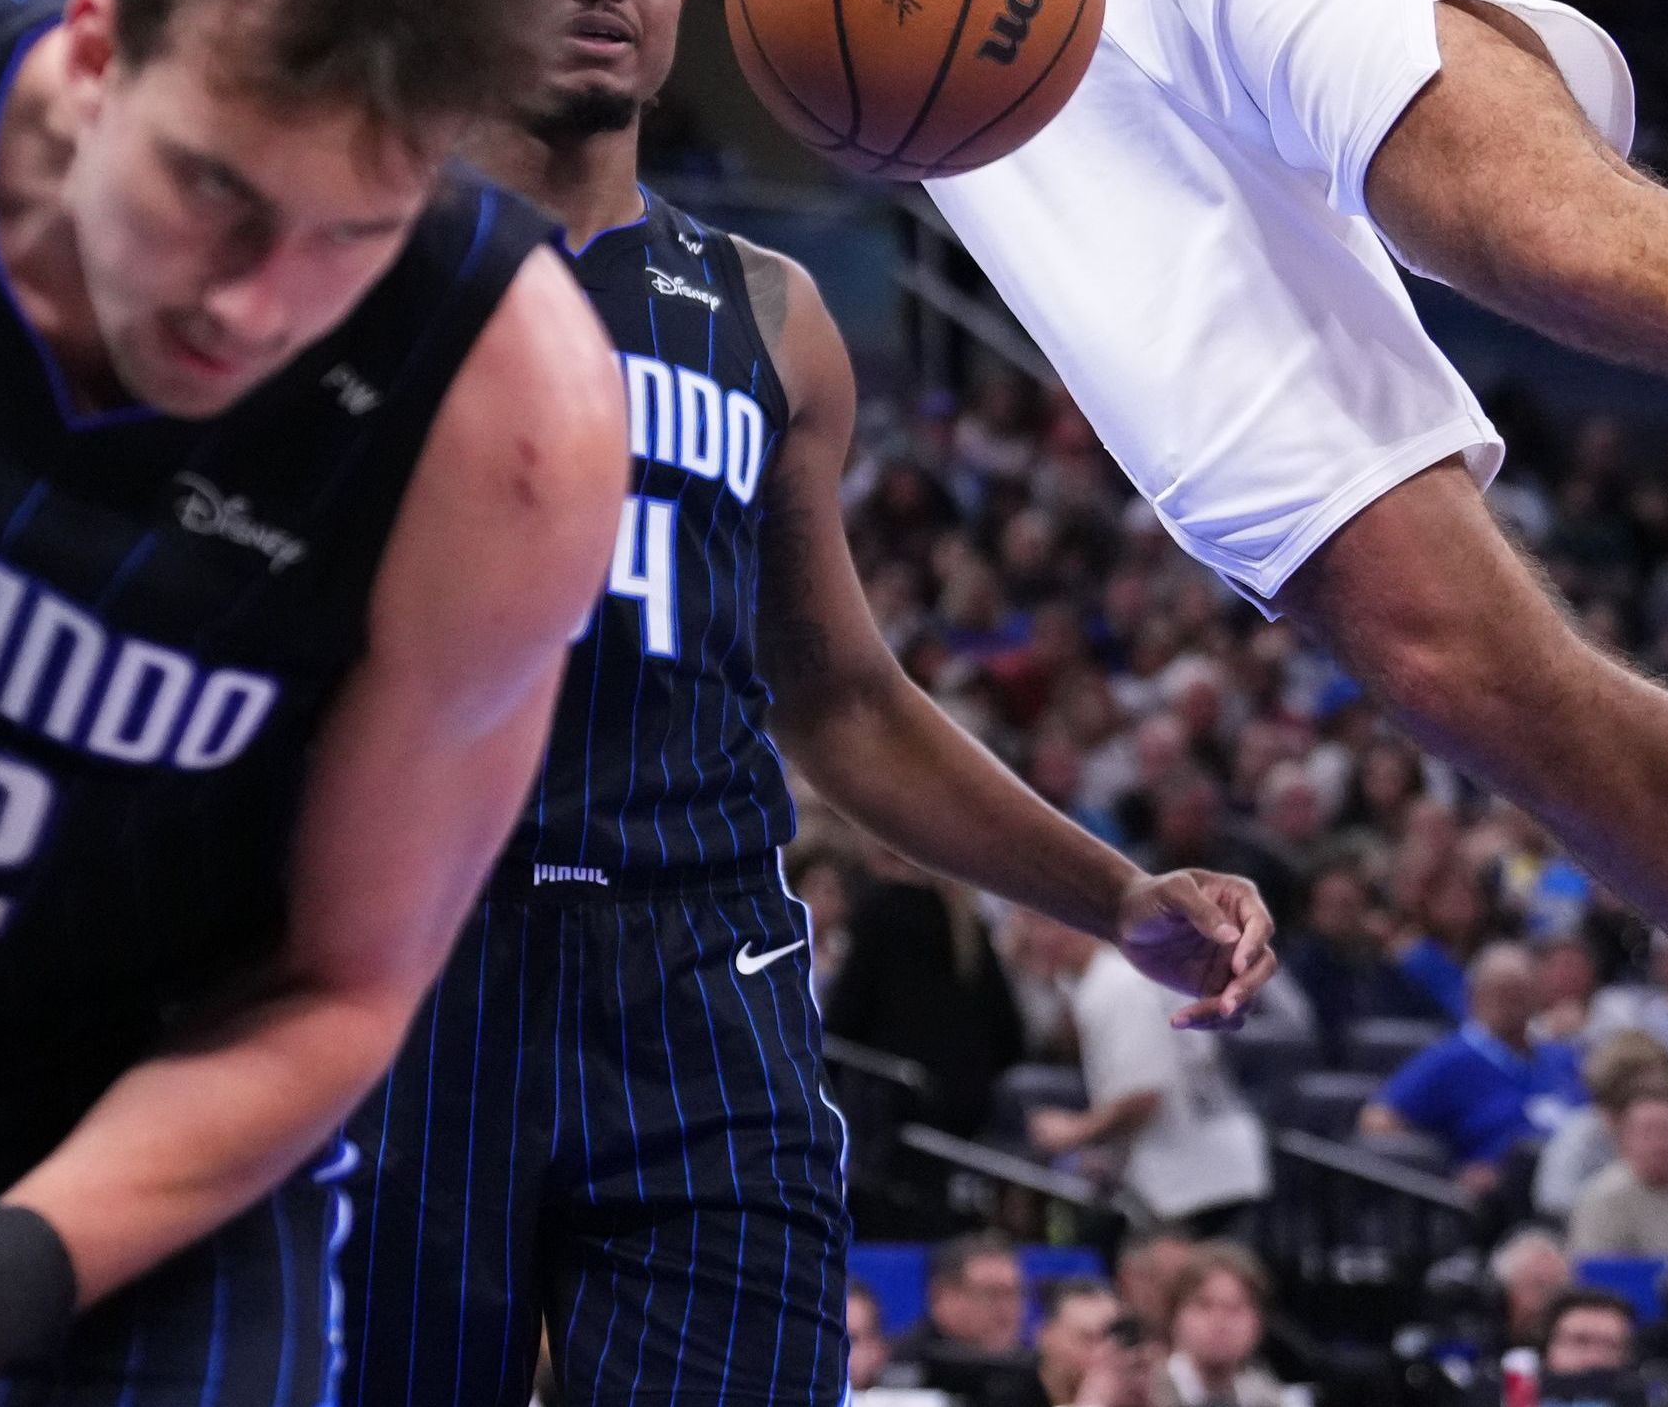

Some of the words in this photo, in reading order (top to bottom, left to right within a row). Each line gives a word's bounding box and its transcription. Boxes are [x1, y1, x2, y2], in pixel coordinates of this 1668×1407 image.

[644, 265, 721, 312] Disney
[616, 354, 764, 506] NDO
[172, 469, 308, 576] Disney
[576, 498, 676, 656] 4
